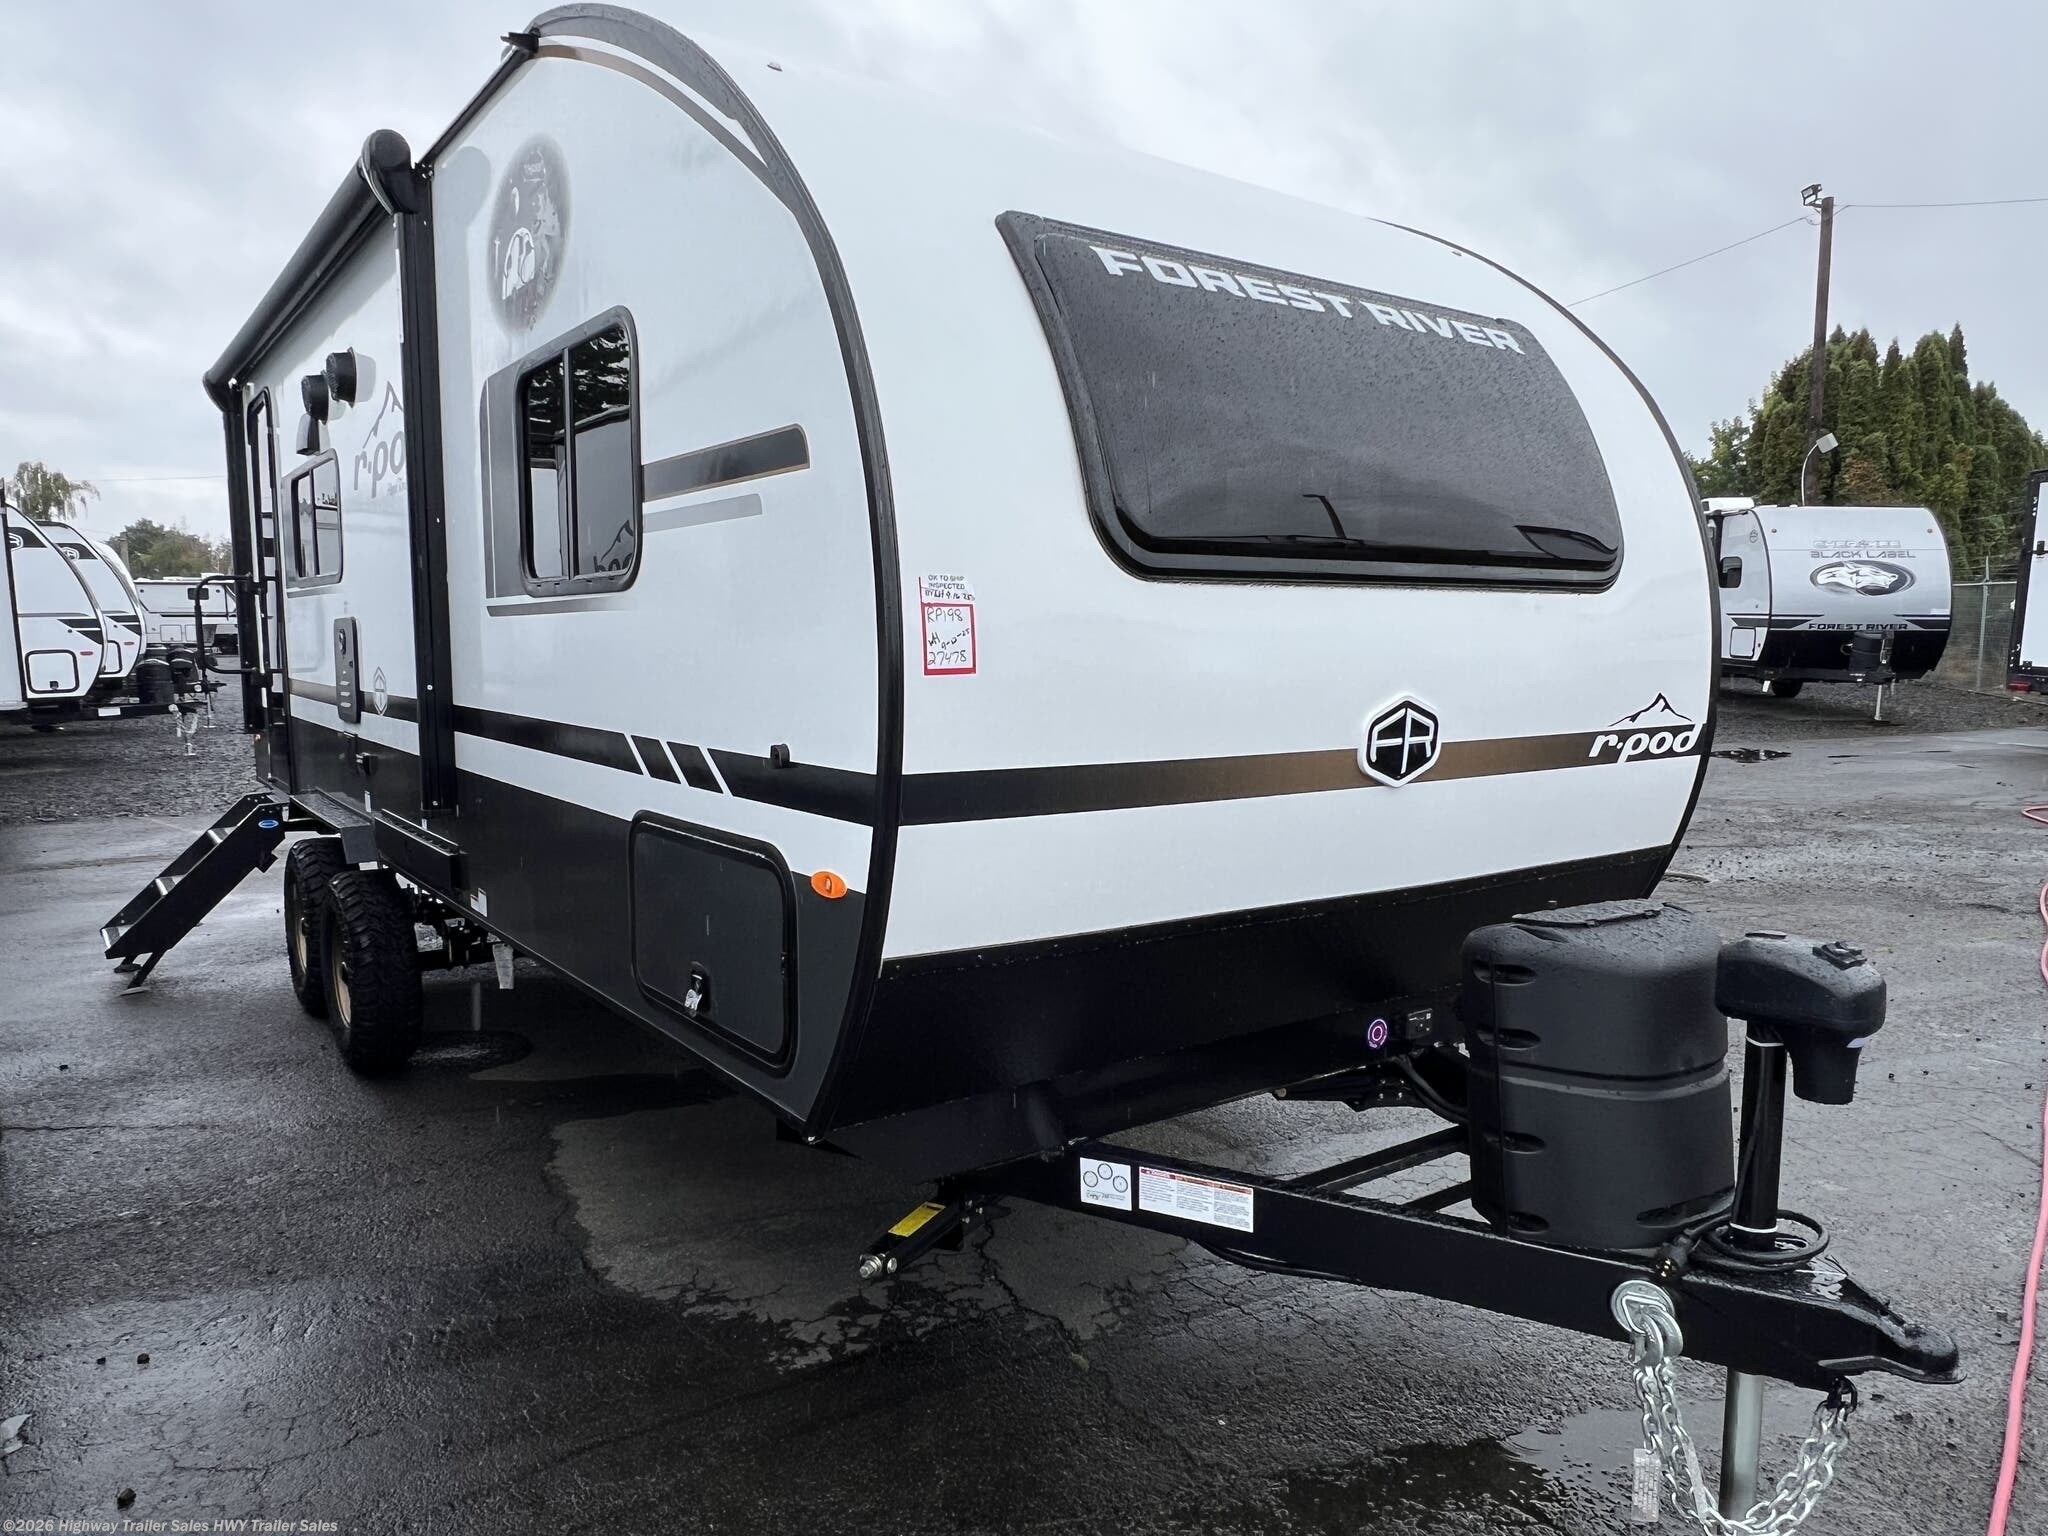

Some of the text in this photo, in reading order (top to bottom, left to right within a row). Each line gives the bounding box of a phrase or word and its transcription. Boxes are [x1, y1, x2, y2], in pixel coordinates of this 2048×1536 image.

[1089, 246, 1526, 355] FOREST RIVER
[1810, 550, 1917, 558] BLACK LABEL
[927, 607, 963, 623] RP198
